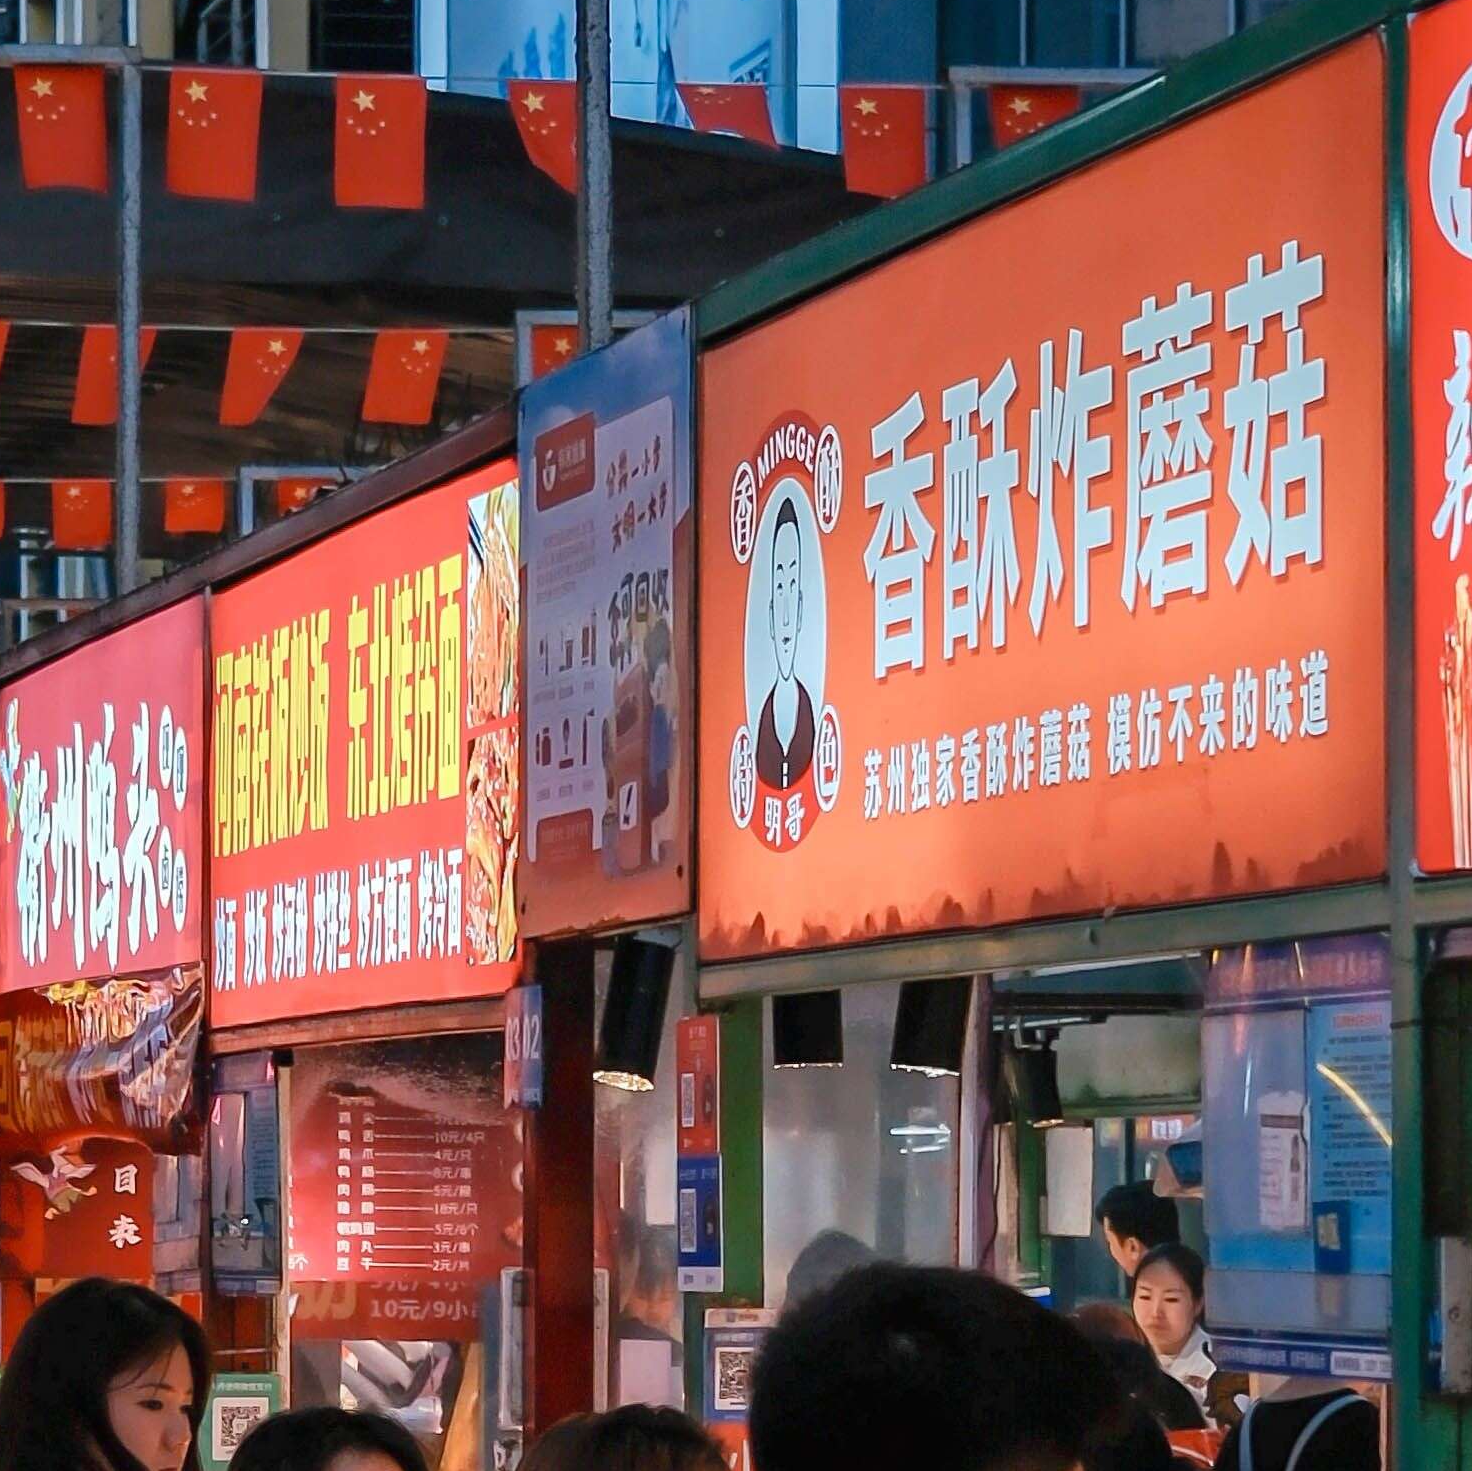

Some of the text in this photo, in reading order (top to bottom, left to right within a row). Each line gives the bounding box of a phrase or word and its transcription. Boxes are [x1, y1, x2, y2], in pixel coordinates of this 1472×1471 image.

[757, 424, 816, 489] MINGGE
[863, 240, 1325, 681] 香酥炸蘑菇
[346, 553, 463, 822] 东北烤冷面
[864, 649, 1330, 822] 苏州独家香酥炸蘑菇 模仿不来的味道
[765, 792, 806, 847] 明哥
[370, 1298, 478, 1321] 10元/9小
